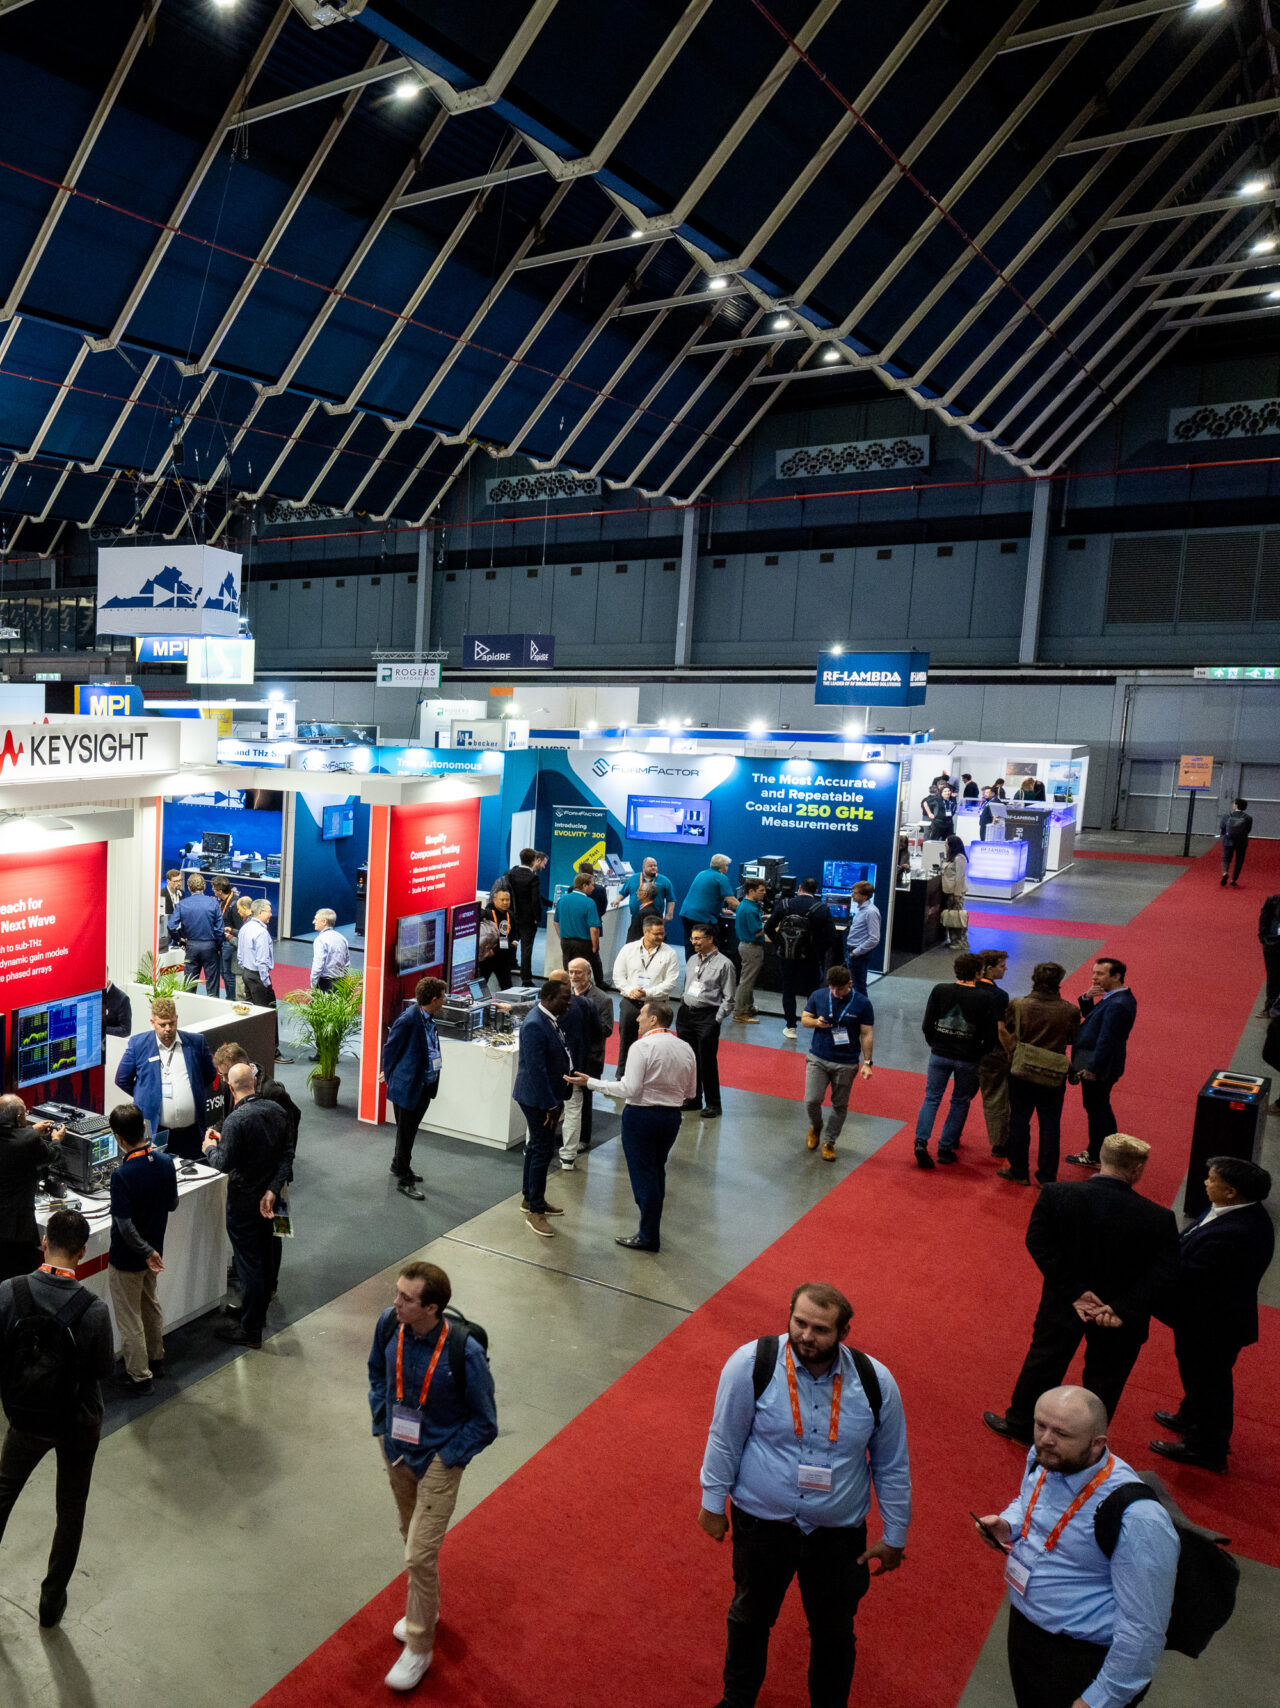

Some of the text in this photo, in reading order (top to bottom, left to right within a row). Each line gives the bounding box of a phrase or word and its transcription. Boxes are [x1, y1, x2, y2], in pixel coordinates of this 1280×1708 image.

[153, 641, 188, 656] MPI
[395, 668, 436, 676] ROGERS
[823, 671, 901, 681] RF-LAMBDA
[90, 695, 131, 717] MPI
[30, 732, 149, 766] KEYSIGHT
[473, 740, 498, 748] becker
[252, 749, 269, 757] THz
[752, 773, 877, 789] The Most Accurate
[761, 789, 864, 803] and Repeatable
[745, 801, 874, 820] Coaxial 250 GHz
[554, 822, 587, 830] Introducing
[762, 816, 859, 832] Measurements
[425, 833, 447, 845] Simplify
[410, 847, 441, 860] Component
[27, 897, 43, 911] for
[0, 918, 26, 934] Next
[27, 914, 56, 929] Wave
[6, 944, 14, 953] to
[14, 938, 42, 951] sub-THz
[29, 951, 44, 964] gain
[44, 946, 69, 959] models
[5, 967, 31, 983] phased
[31, 965, 52, 976] arrays
